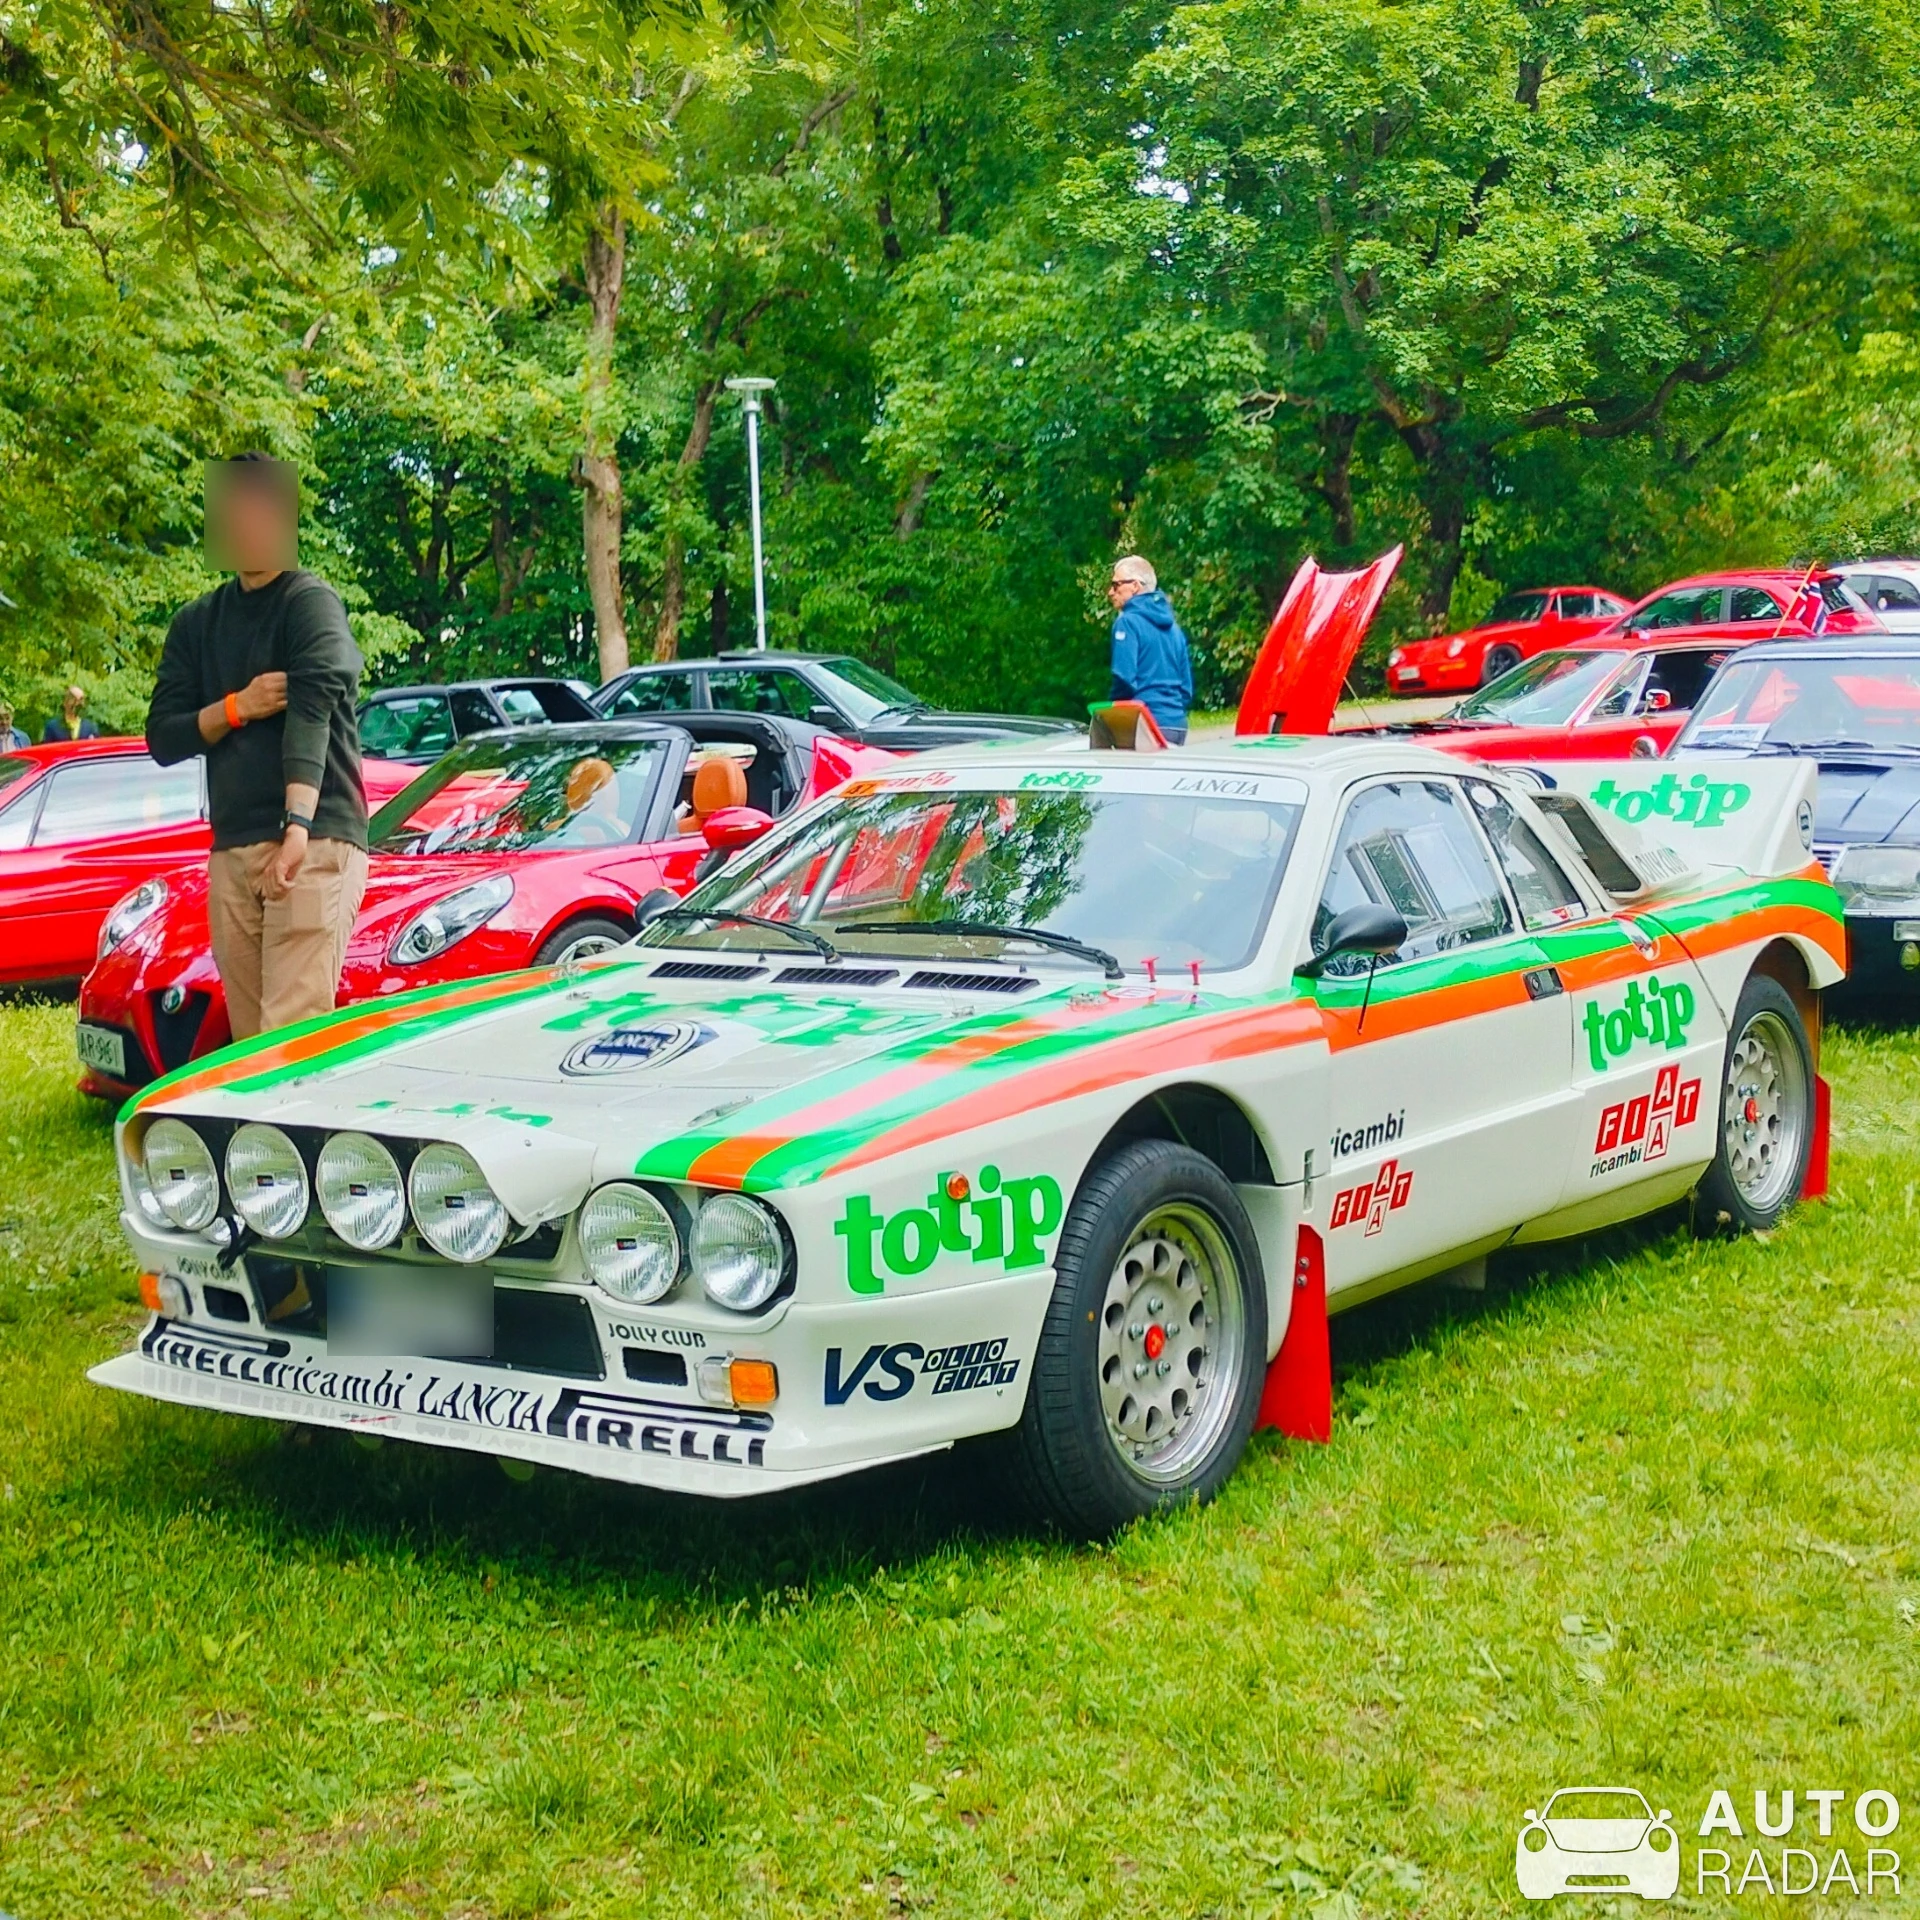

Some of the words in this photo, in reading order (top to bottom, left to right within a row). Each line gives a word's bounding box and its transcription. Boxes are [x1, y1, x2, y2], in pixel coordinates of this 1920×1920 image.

[1018, 771, 1103, 790] totip
[1170, 777, 1260, 797] LANCIA
[1590, 773, 1752, 828] totip
[1583, 976, 1694, 1071] totip
[1331, 1109, 1406, 1159] icambi
[1597, 1066, 1699, 1152] FIAT
[1590, 1143, 1643, 1178] ricambi
[1331, 1162, 1412, 1228] FIAT
[834, 1164, 1063, 1294] totip
[608, 1322, 657, 1343] JOLLY
[661, 1329, 706, 1348] CLUB
[923, 1340, 1007, 1371] OLIO
[142, 1316, 291, 1385] PIRELLI
[276, 1355, 414, 1410] ricambi
[416, 1376, 544, 1434] LANCIA
[547, 1387, 775, 1468] PIRELLI
[824, 1342, 925, 1405] VS
[934, 1361, 1019, 1393] FIAT
